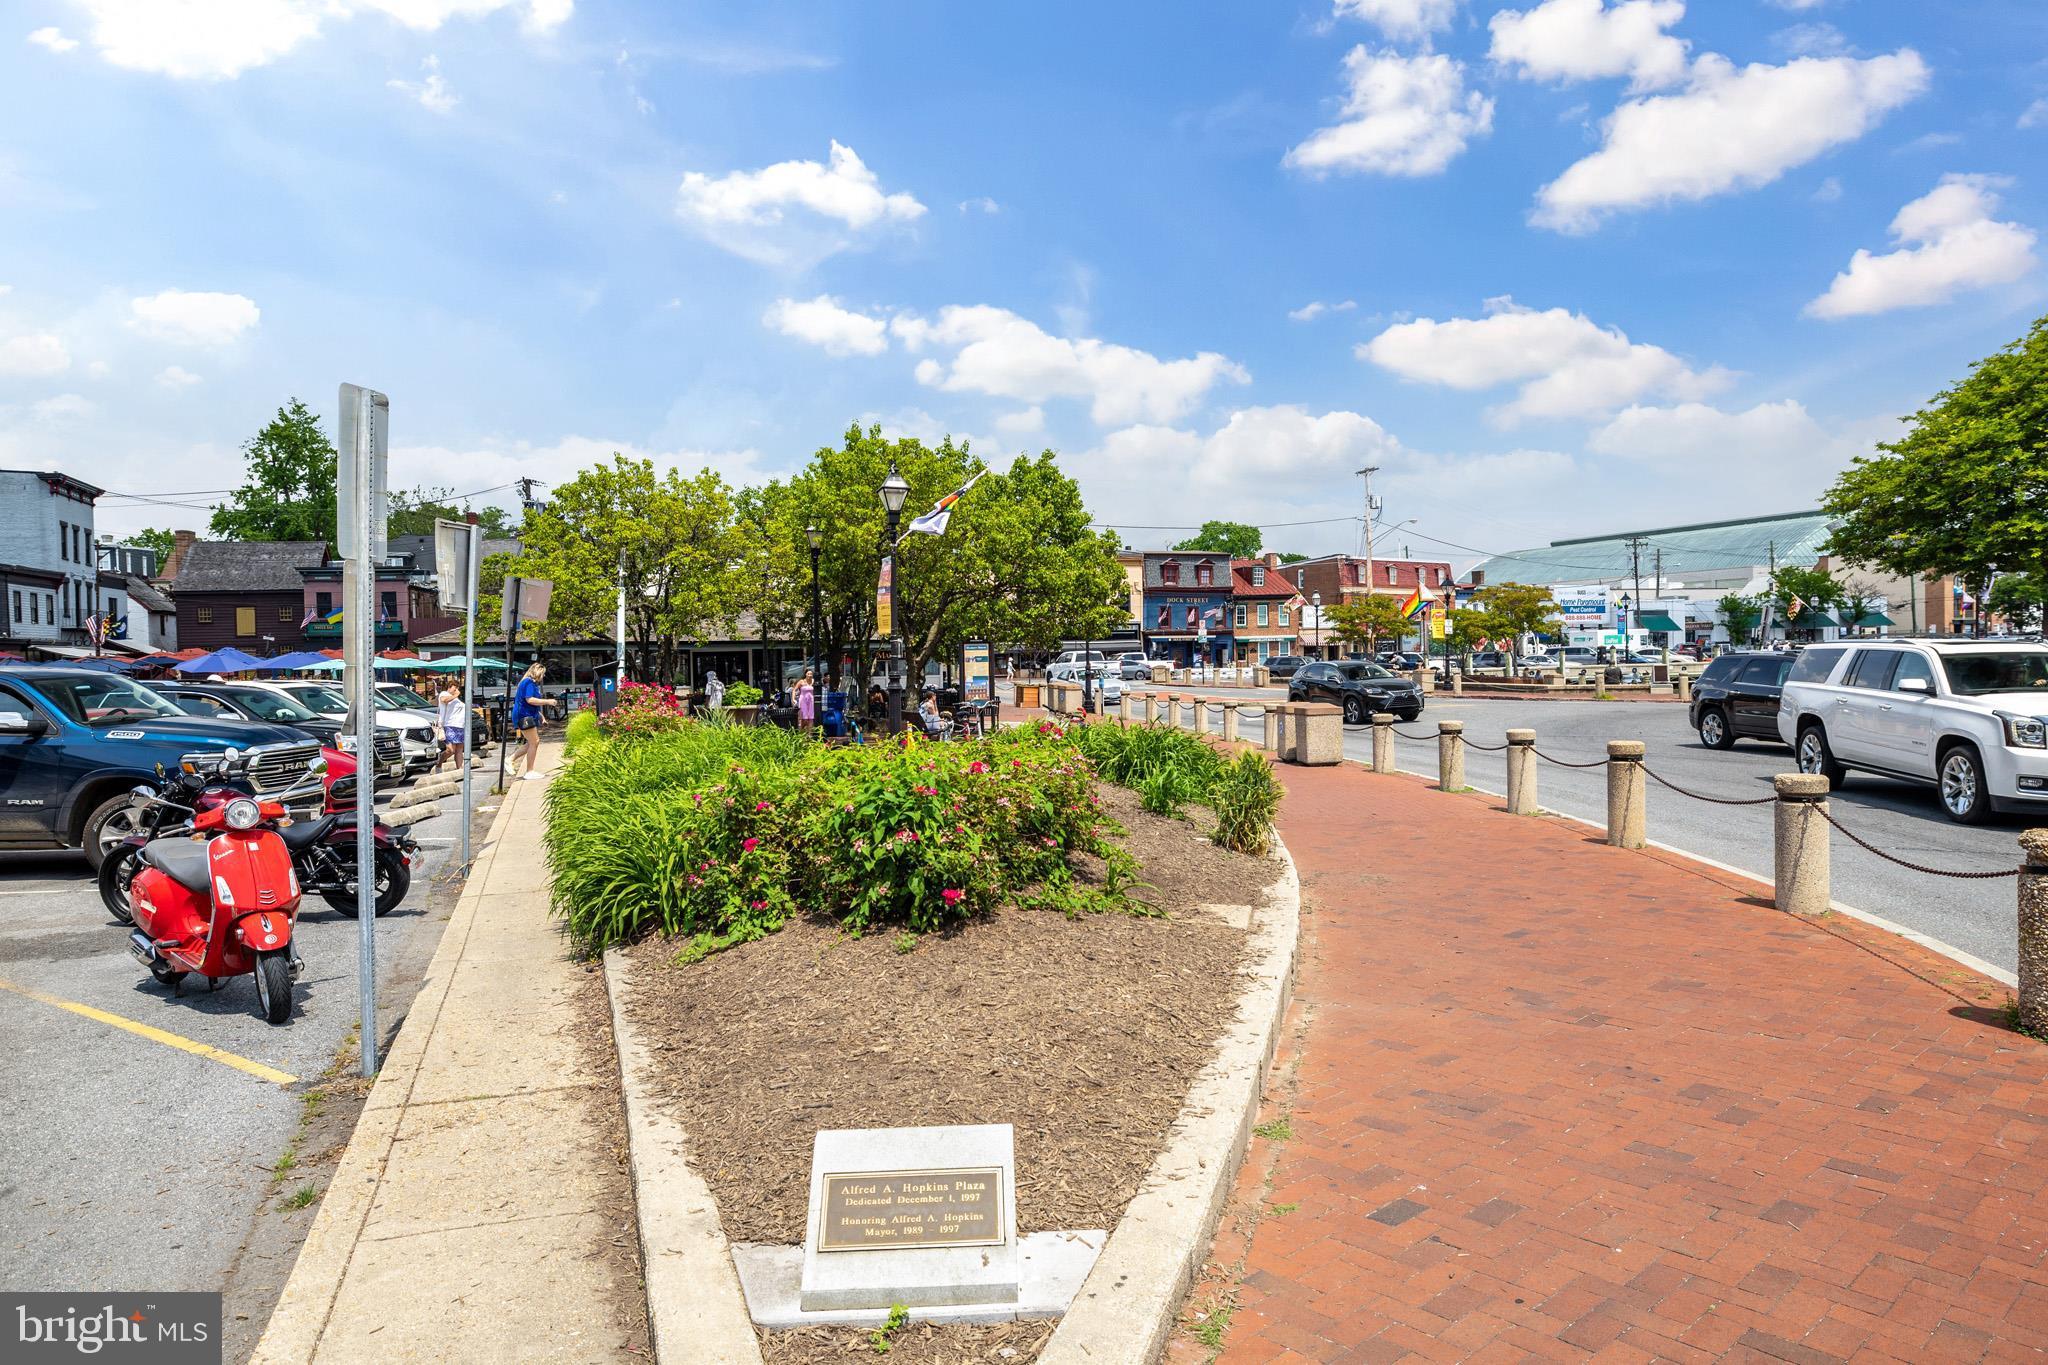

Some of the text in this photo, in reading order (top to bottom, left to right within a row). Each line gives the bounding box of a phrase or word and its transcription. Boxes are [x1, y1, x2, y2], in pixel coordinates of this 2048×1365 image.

[605, 679, 612, 690] P
[841, 1181, 986, 1195] Alfred A. Hopkins Plaza
[845, 1196, 892, 1206] Dedicated
[897, 1195, 944, 1204] December
[961, 1193, 980, 1202] 1997
[841, 1212, 984, 1226] Honoring Alfred A. Hopkins
[865, 1227, 898, 1238] Mayor,
[903, 1226, 923, 1235] 1989
[940, 1225, 960, 1234] 1997
